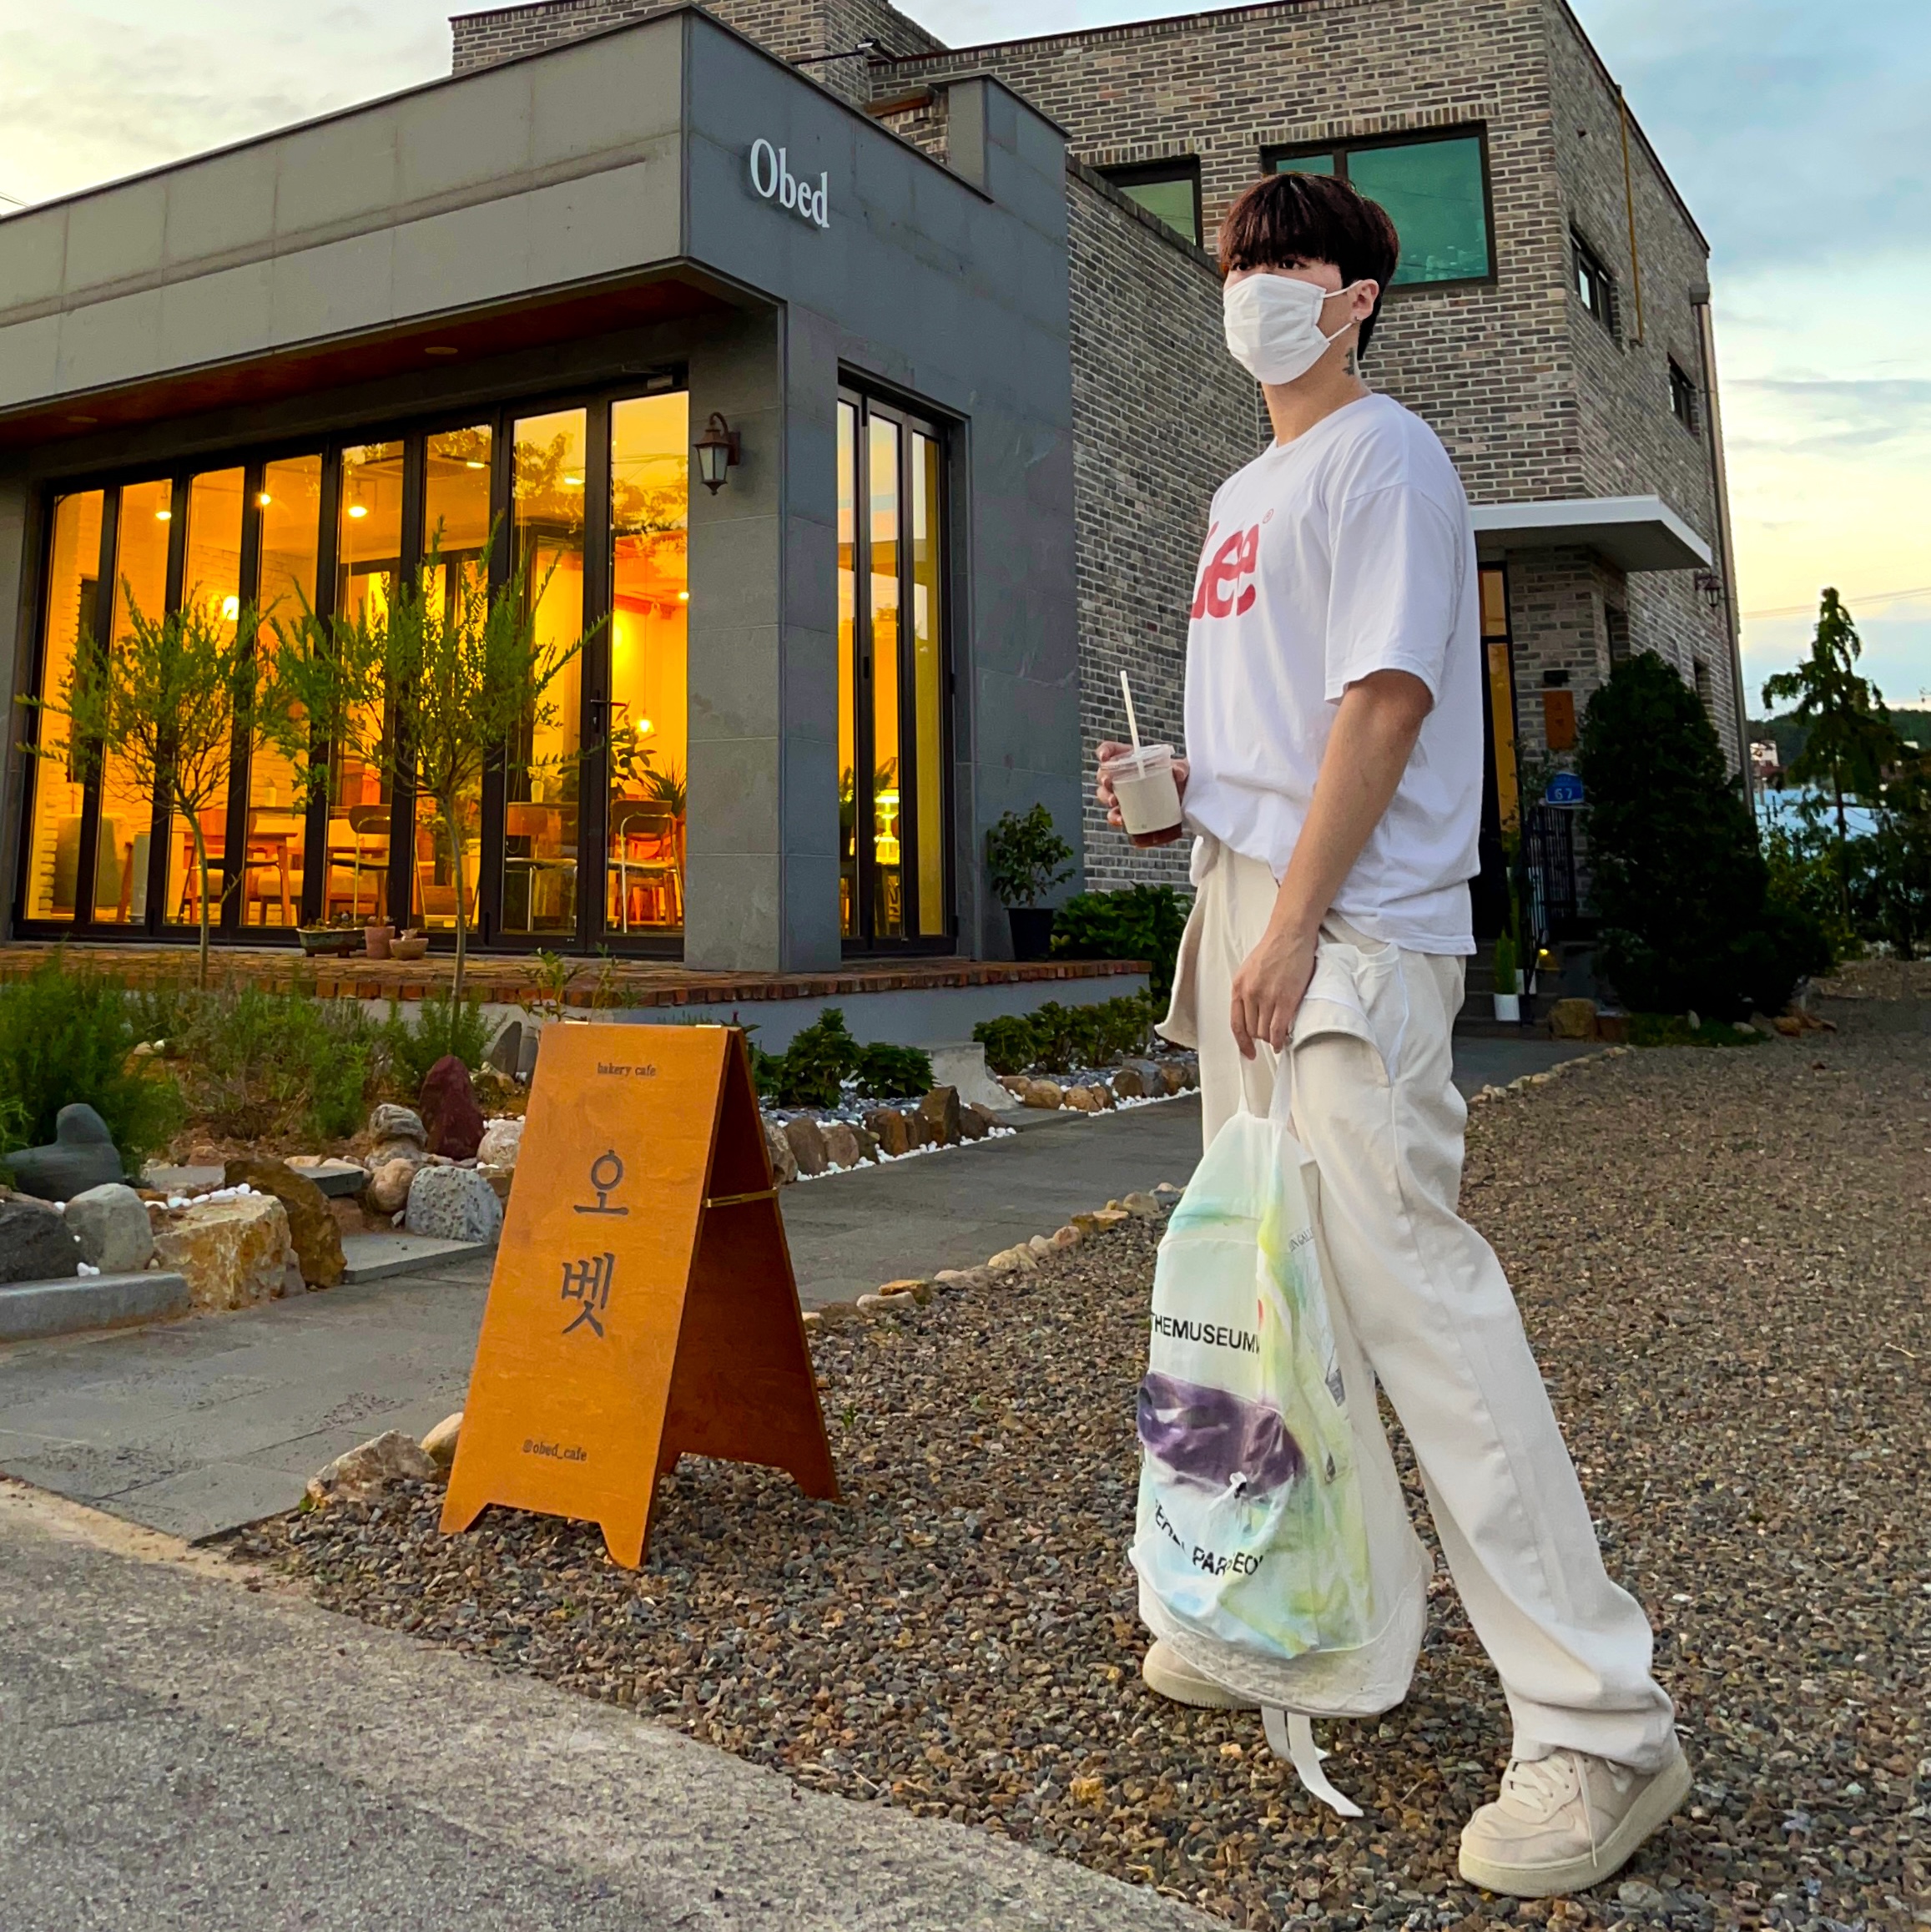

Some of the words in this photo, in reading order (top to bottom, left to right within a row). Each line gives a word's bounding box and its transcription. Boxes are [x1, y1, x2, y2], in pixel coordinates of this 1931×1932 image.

[750, 138, 830, 229] Obed
[1554, 787, 1573, 800] 67
[597, 1061, 633, 1077] bakery
[634, 1063, 657, 1077] cafe
[562, 1148, 630, 1338] 오벳
[522, 1438, 587, 1461] @obed_cafe
